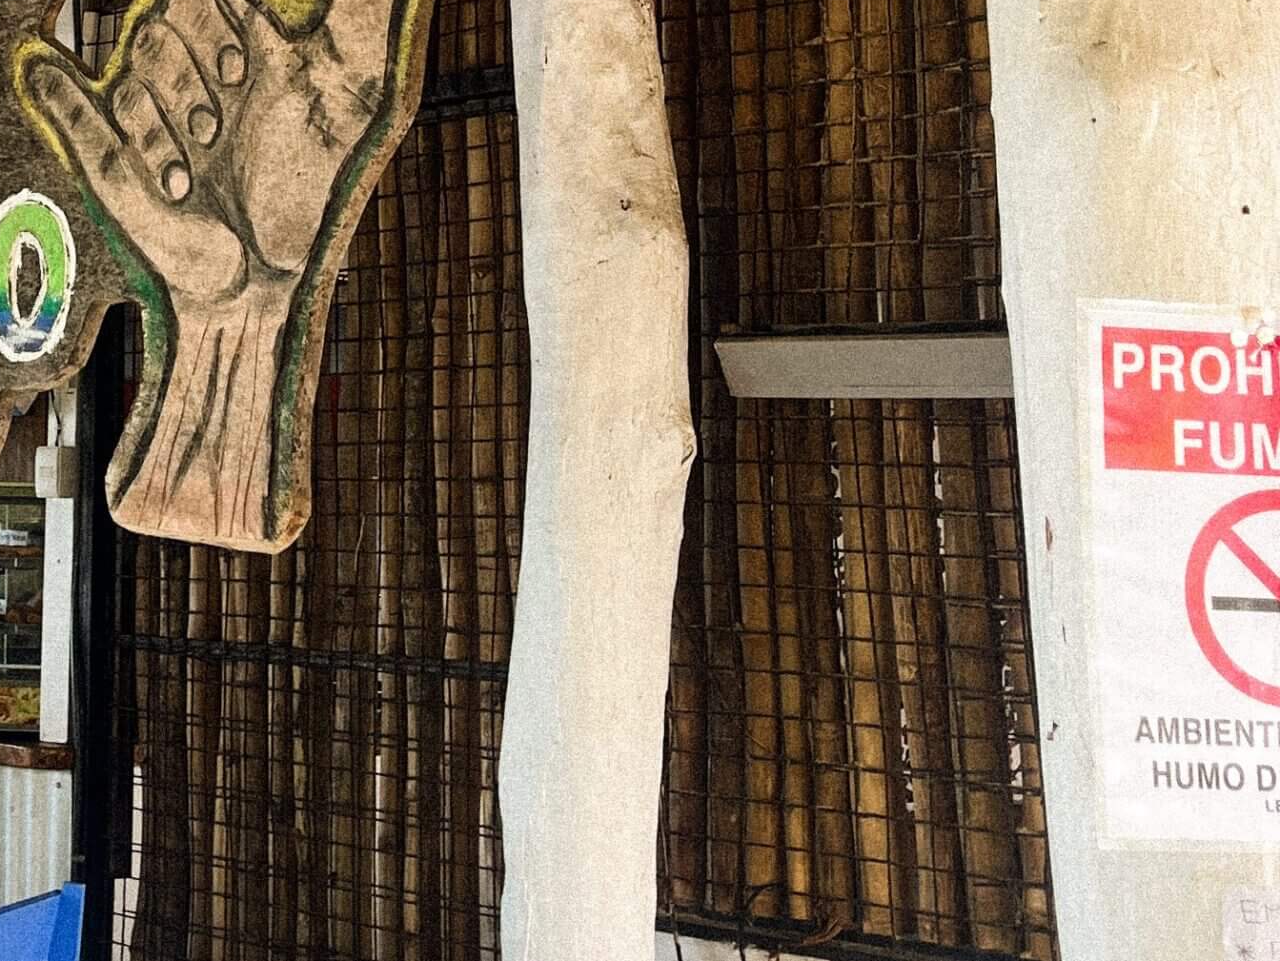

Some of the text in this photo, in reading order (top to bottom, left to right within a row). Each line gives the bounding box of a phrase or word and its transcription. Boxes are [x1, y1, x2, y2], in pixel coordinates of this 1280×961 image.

[1112, 341, 1280, 397] PROH
[1134, 715, 1280, 749] AMBIENT
[1152, 760, 1246, 792] HUMO
